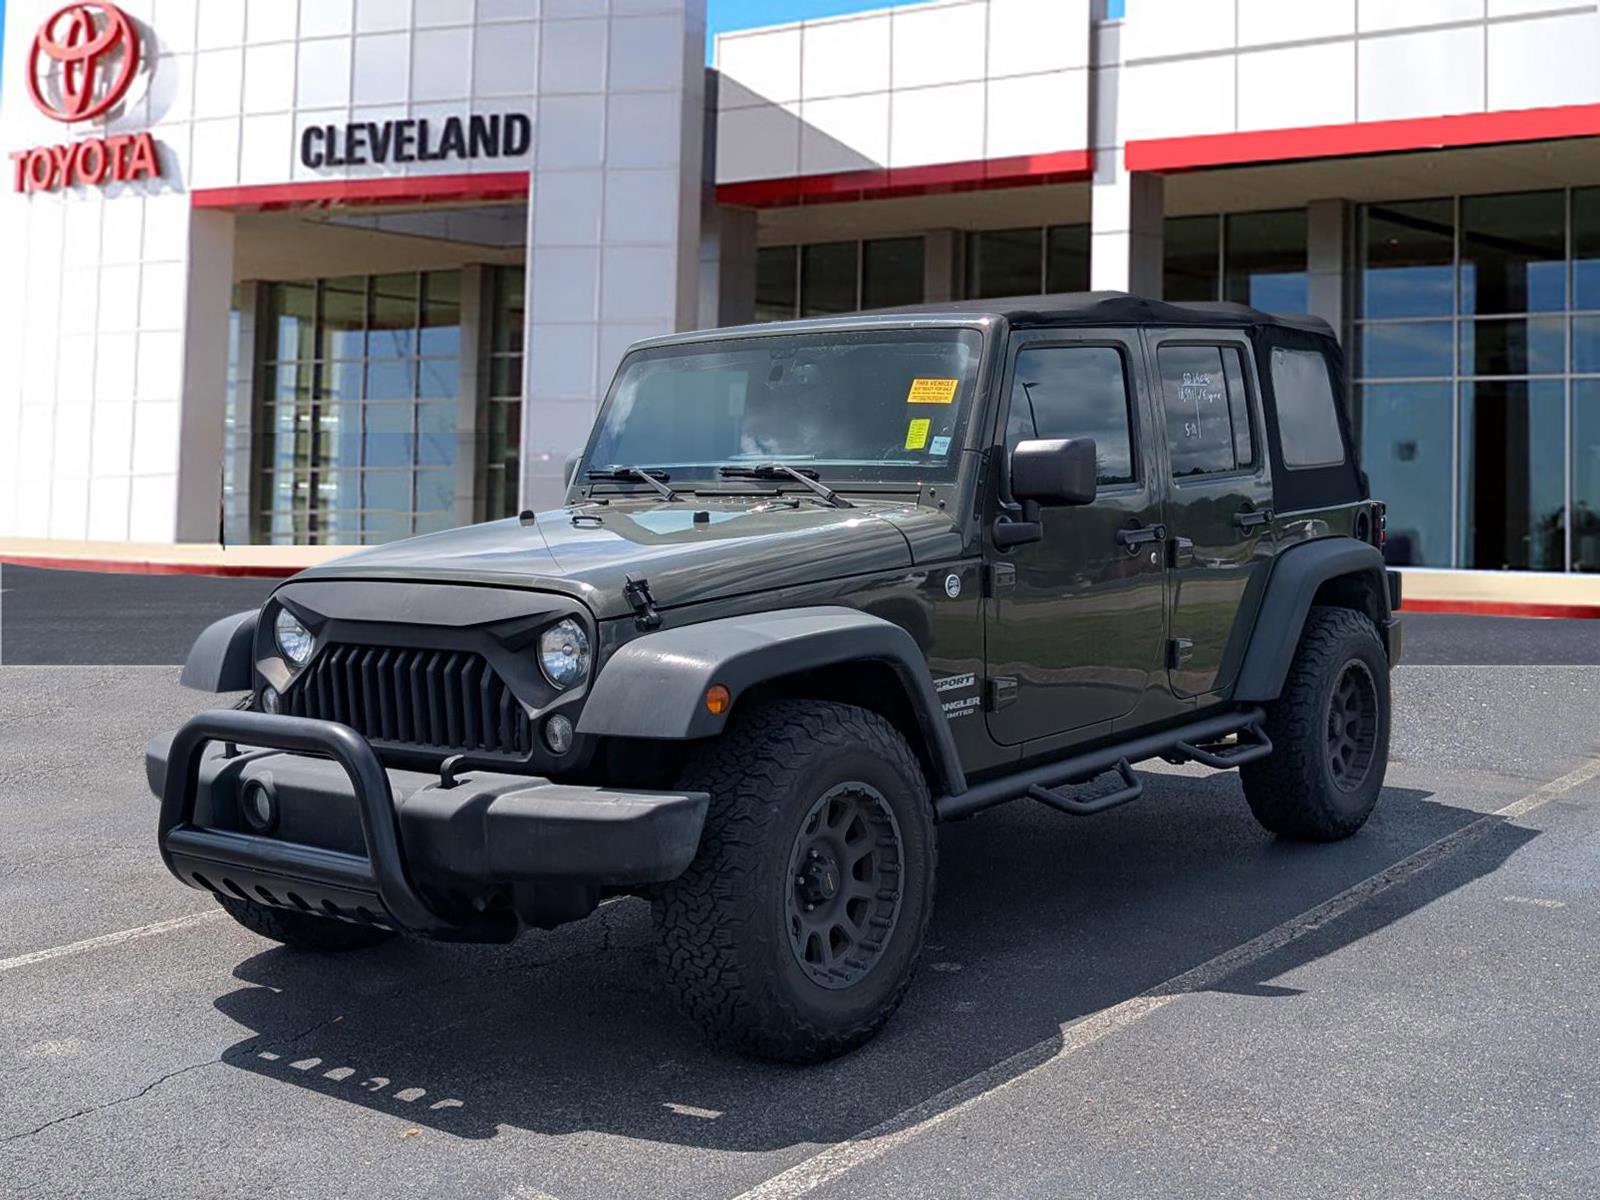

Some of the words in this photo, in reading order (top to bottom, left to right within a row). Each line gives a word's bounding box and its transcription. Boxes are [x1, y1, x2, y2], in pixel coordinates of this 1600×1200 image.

[9, 132, 161, 193] TOYOTA
[301, 113, 531, 169] CLEVELAND
[934, 676, 970, 689] SPORT
